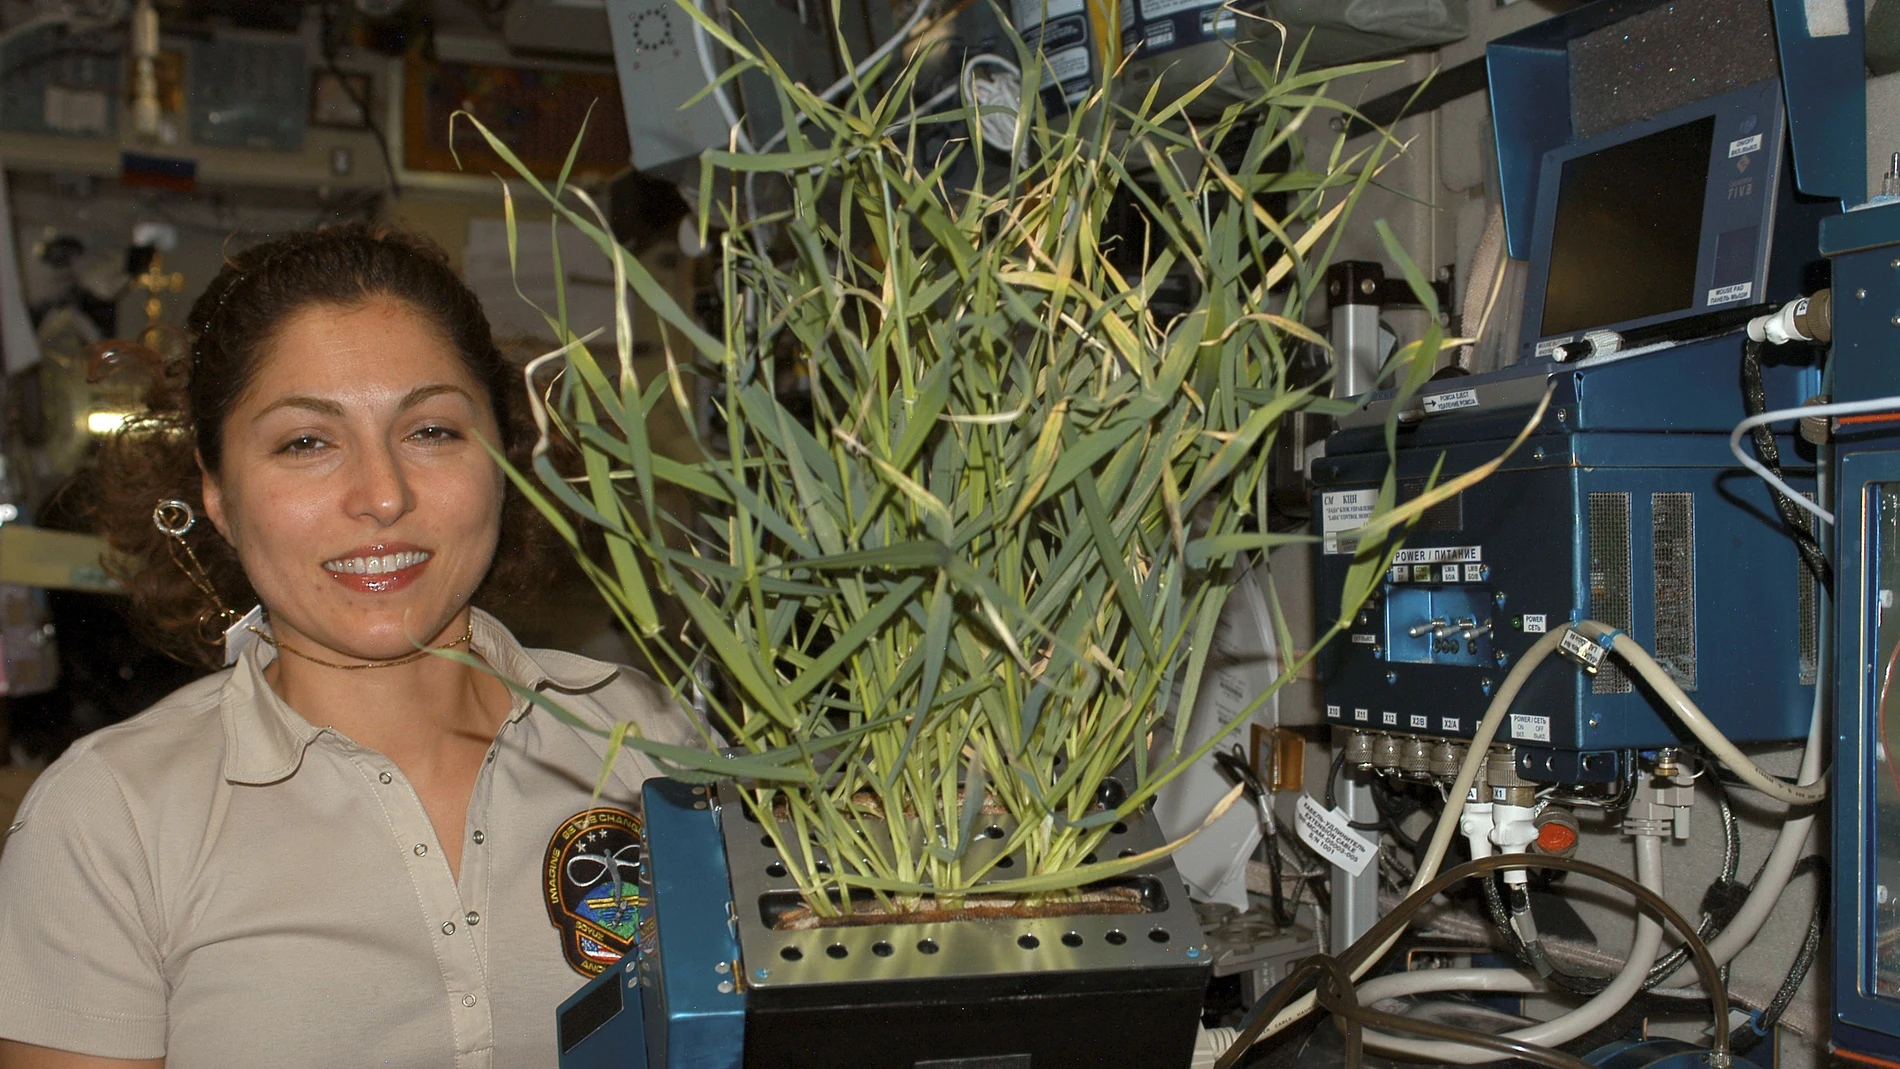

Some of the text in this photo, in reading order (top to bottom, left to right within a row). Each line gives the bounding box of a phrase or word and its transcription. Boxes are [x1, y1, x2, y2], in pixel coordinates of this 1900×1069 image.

[1716, 287, 1733, 295] MOUSE
[1710, 295, 1730, 304] ПАНЕЛЬ
[1395, 551, 1425, 562] POWER
[1435, 548, 1476, 560] ПИТАНИЕ
[1329, 708, 1338, 716] X10
[1357, 711, 1366, 719] X11
[1385, 714, 1394, 723] X12
[1412, 717, 1425, 726] X2/B
[1534, 717, 1546, 725] СЕТЬ
[1444, 719, 1457, 728] X2/A
[1494, 789, 1503, 797] X1
[1303, 802, 1366, 853] КАБЕЛЬ-УДЛИНИТЕЛЬ
[1304, 812, 1356, 853] EXTENSION CABLE
[1308, 832, 1335, 855] S/N 1001
[549, 848, 561, 904] IMAGINE
[562, 825, 577, 840] BE
[599, 814, 640, 834] CHANG
[575, 921, 605, 942] SOYUZ
[581, 961, 607, 974] ANO
[1274, 1016, 1292, 1029] CABLE
